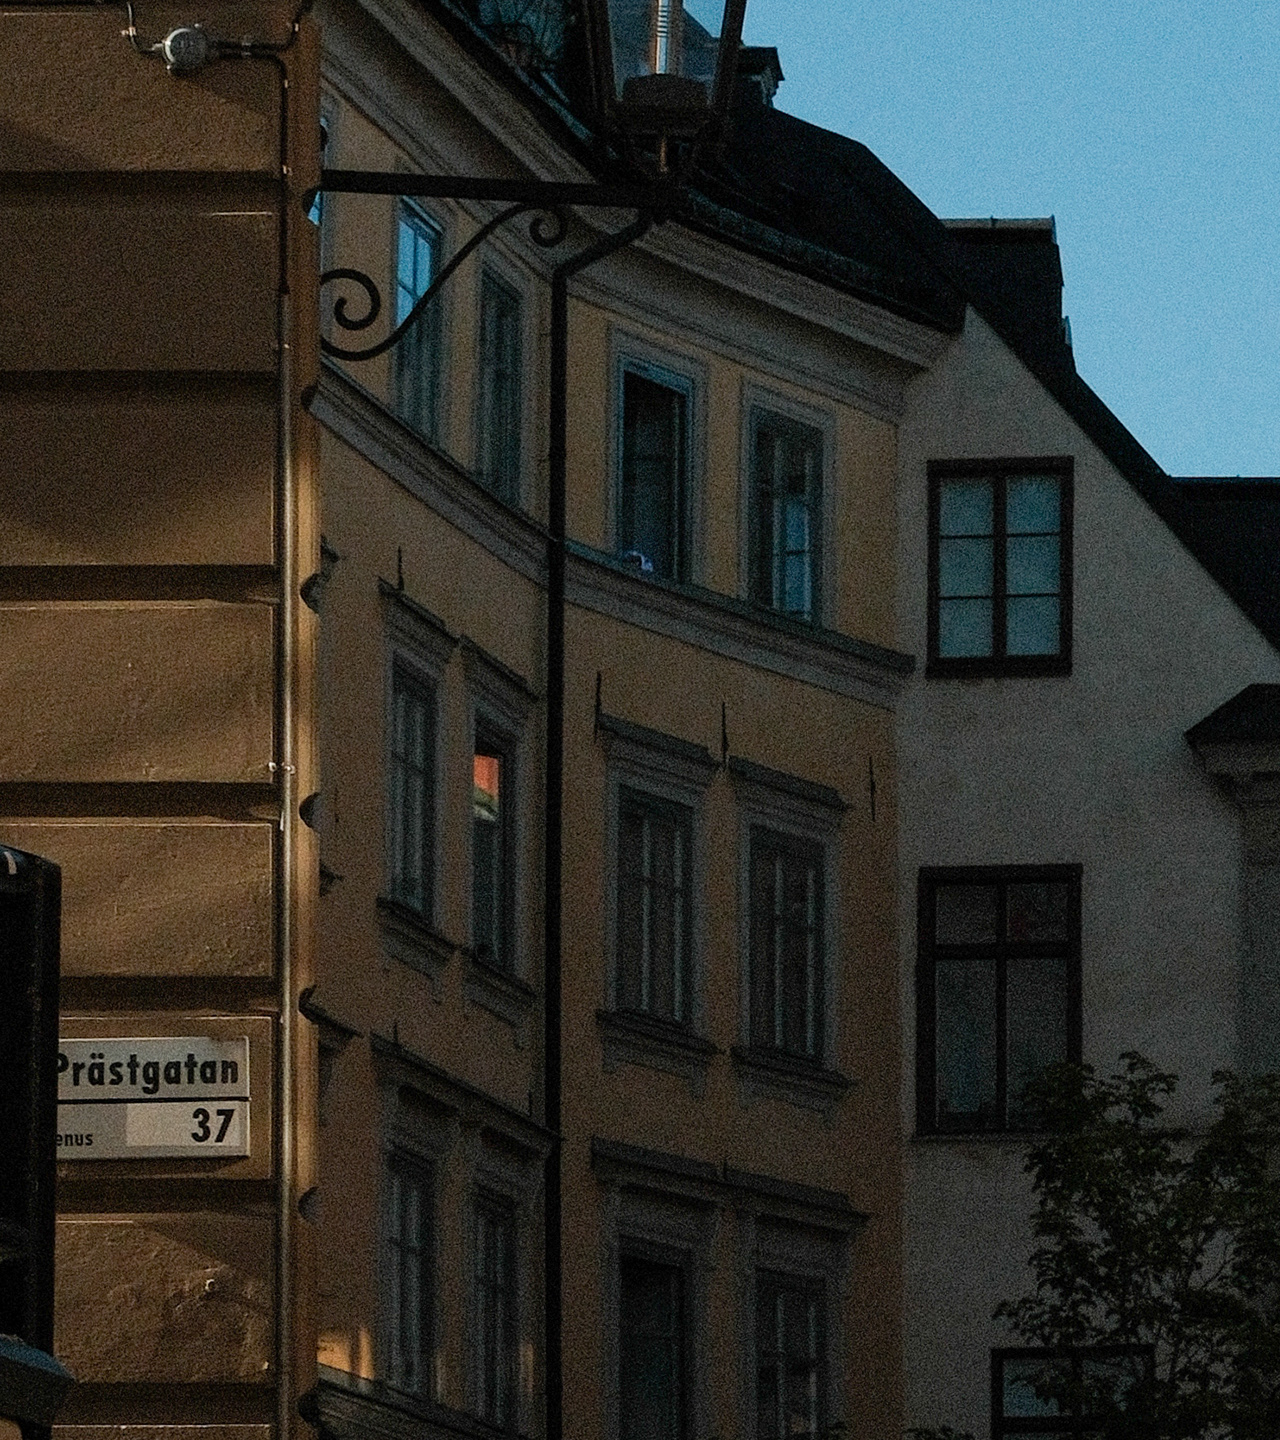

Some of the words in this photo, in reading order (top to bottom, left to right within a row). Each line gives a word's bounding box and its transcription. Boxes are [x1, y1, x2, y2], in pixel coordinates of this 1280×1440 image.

[56, 1053, 239, 1095] Prästgatan
[55, 1133, 94, 1147] enus
[190, 1108, 236, 1143] 37
